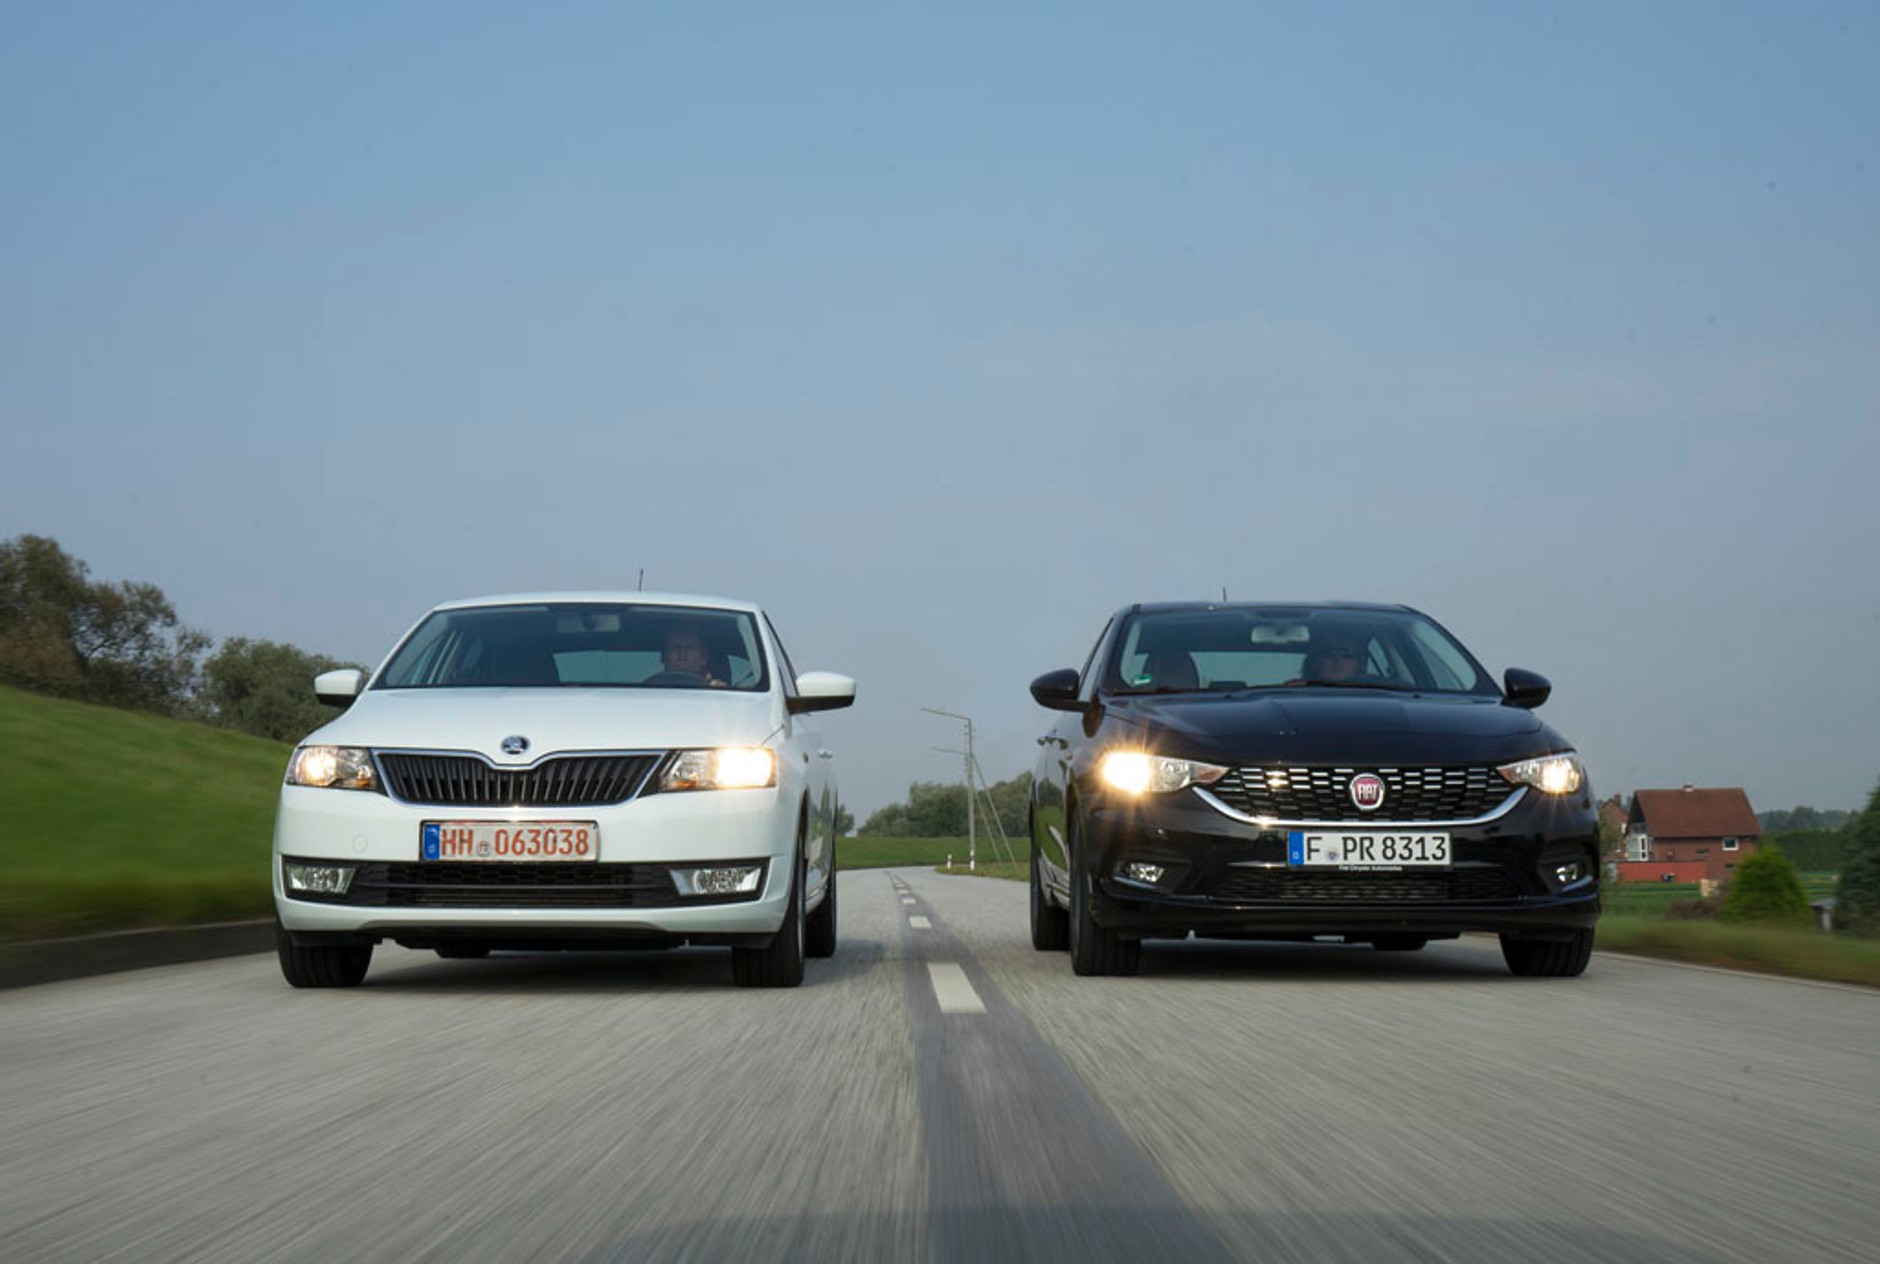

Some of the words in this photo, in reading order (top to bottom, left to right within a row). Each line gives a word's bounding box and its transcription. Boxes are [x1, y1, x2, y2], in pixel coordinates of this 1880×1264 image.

[1358, 784, 1379, 800] FIAT
[441, 829, 474, 856] HH
[494, 829, 589, 856] 063038
[1306, 836, 1323, 861] F
[1342, 836, 1375, 861] PR
[1382, 836, 1446, 861] 8313
